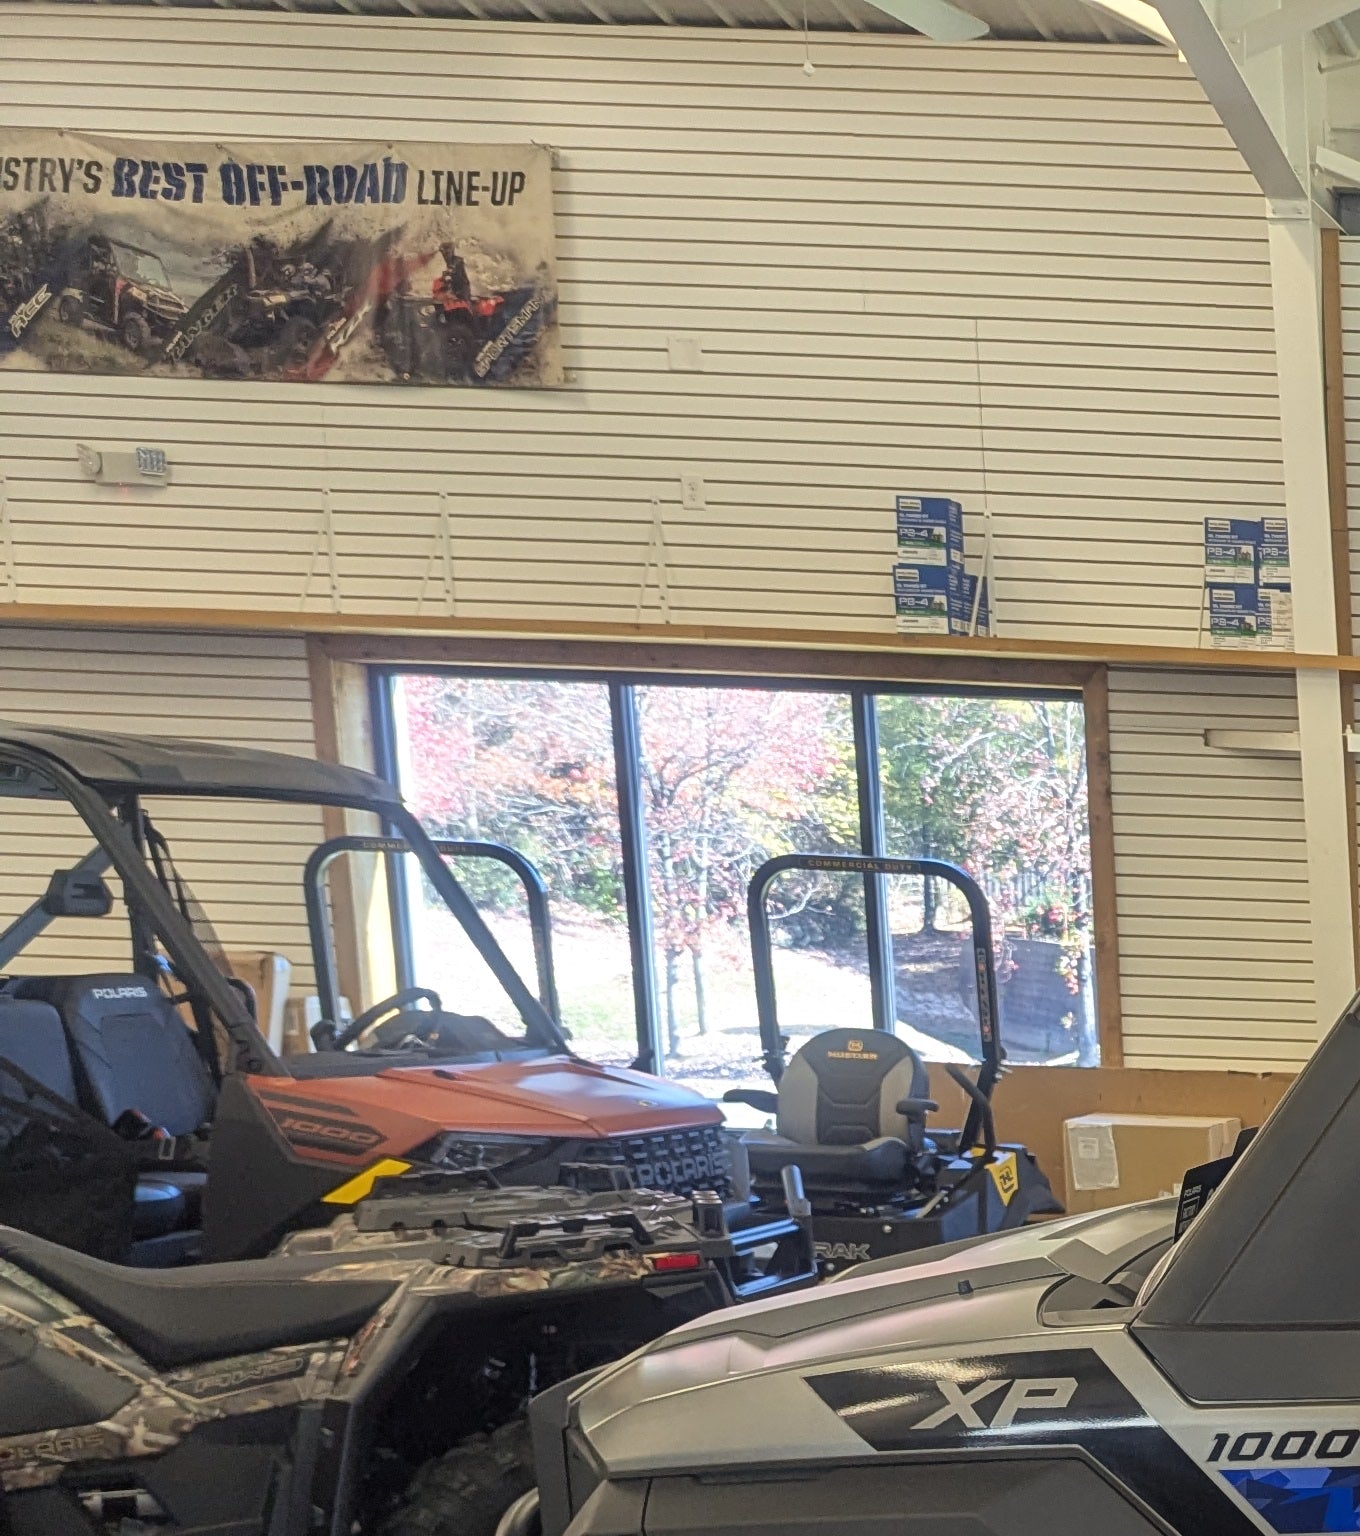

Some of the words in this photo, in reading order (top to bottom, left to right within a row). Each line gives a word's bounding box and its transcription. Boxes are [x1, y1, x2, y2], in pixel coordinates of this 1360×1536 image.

[0, 157, 103, 194] STRY'S
[112, 157, 208, 204] BEST
[219, 157, 409, 207] OFF-ROAD
[417, 169, 526, 207] LINE-UP
[92, 986, 148, 999] POLARIS
[281, 1118, 378, 1146] 1000
[635, 1151, 729, 1188] POLARIS
[909, 1376, 1079, 1431] XP
